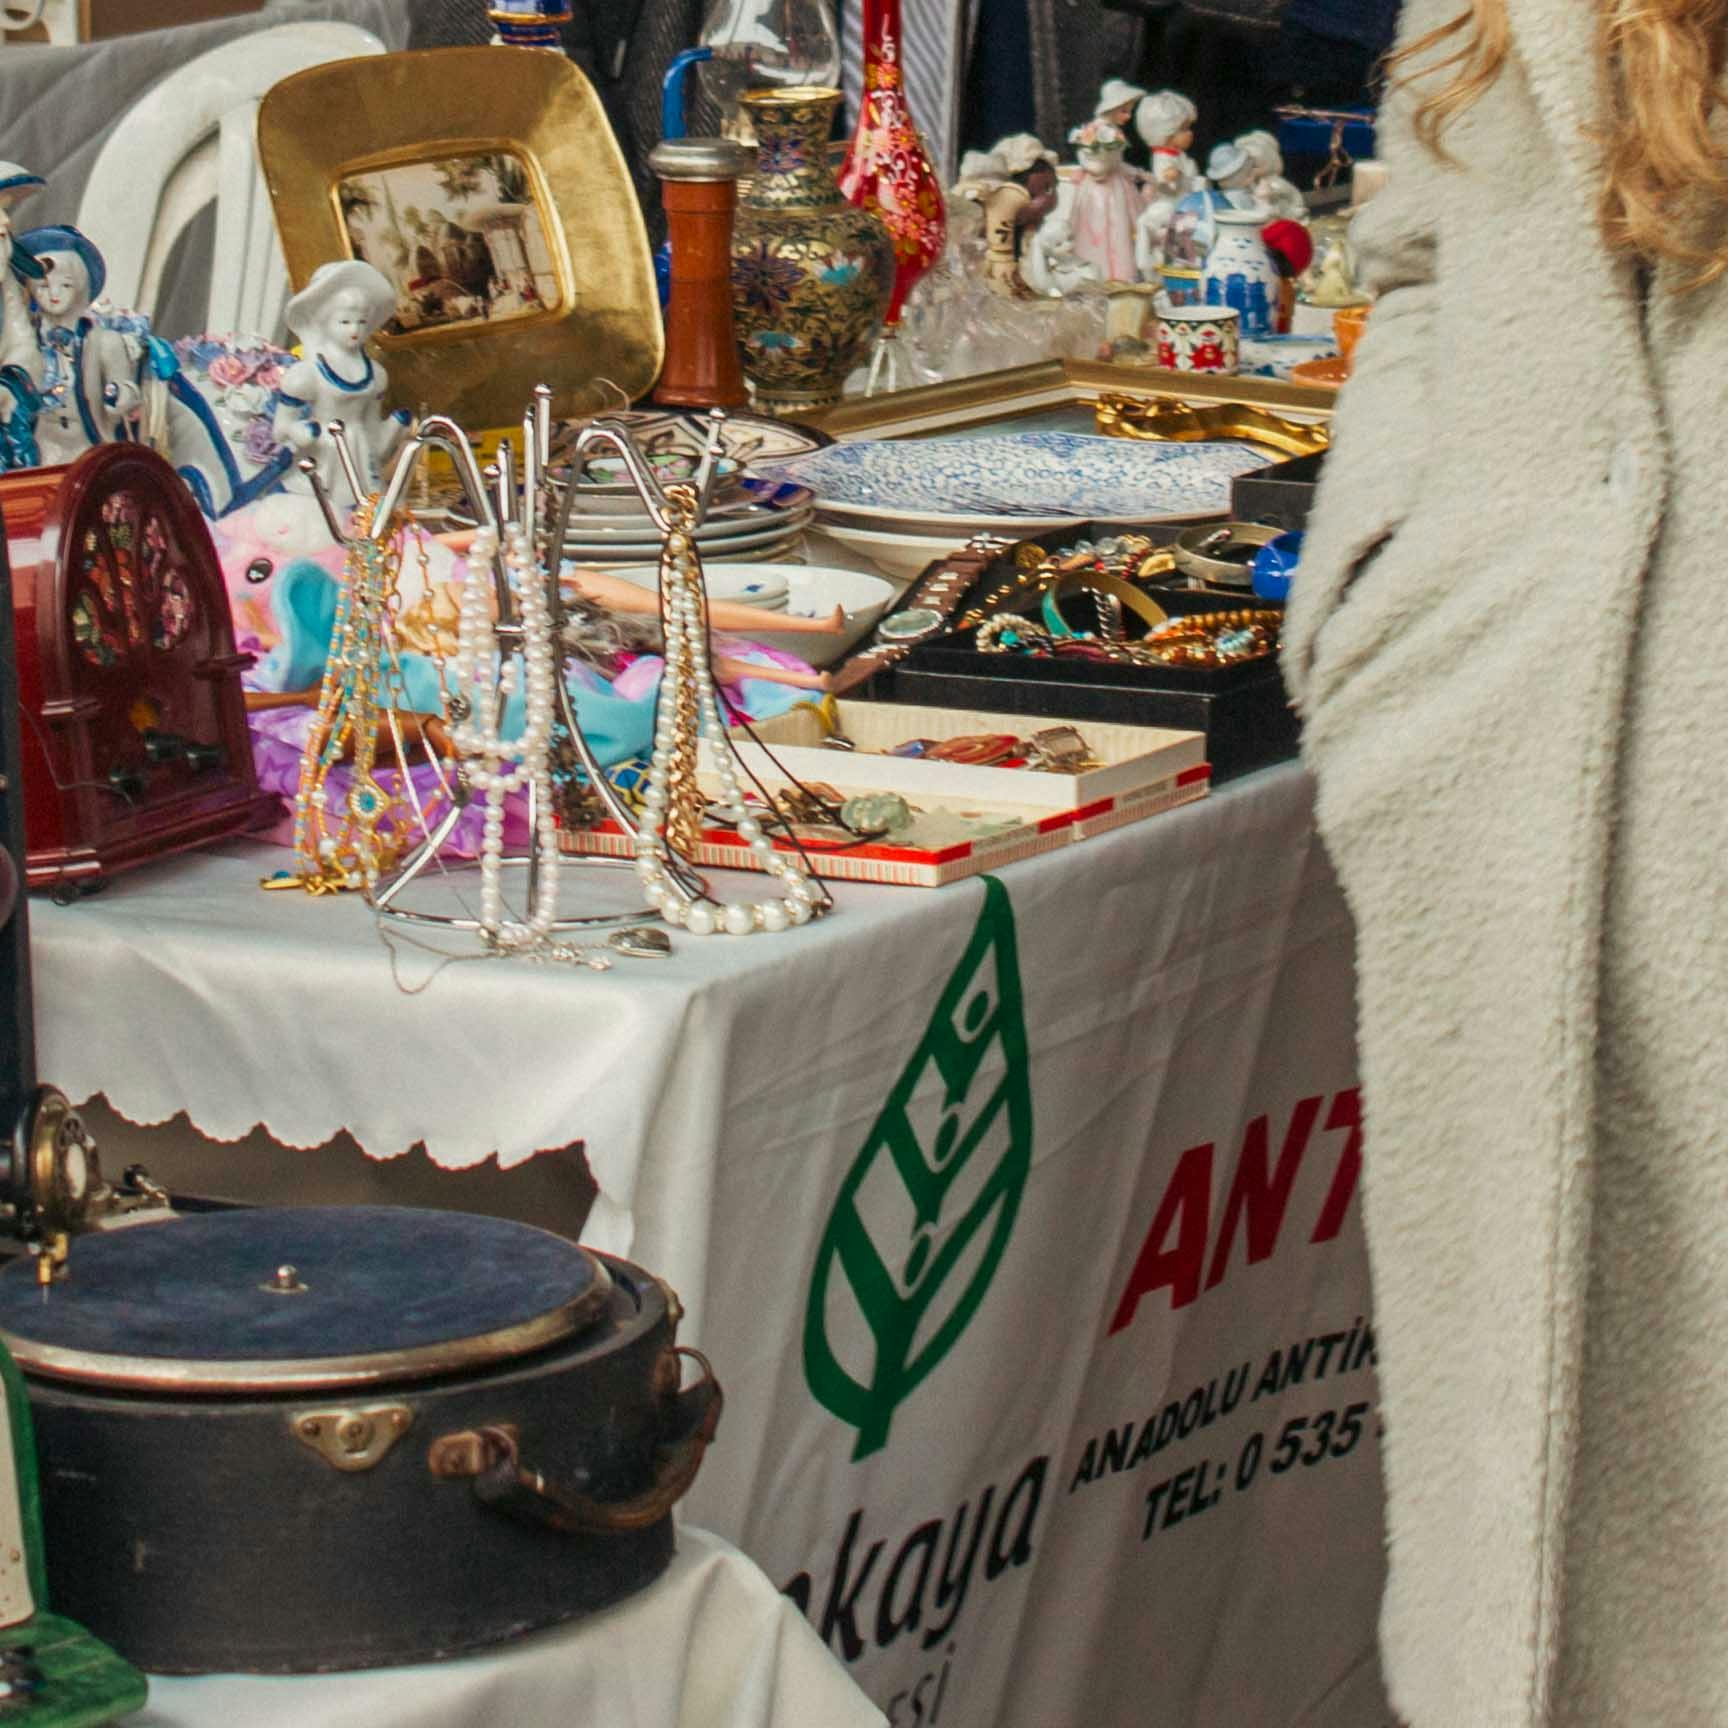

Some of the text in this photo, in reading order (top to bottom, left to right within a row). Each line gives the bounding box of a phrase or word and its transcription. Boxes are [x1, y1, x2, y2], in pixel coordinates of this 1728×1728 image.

[1069, 1362, 1251, 1494] ANADOLU
[1142, 1402, 1369, 1542] TEL: 0 535
